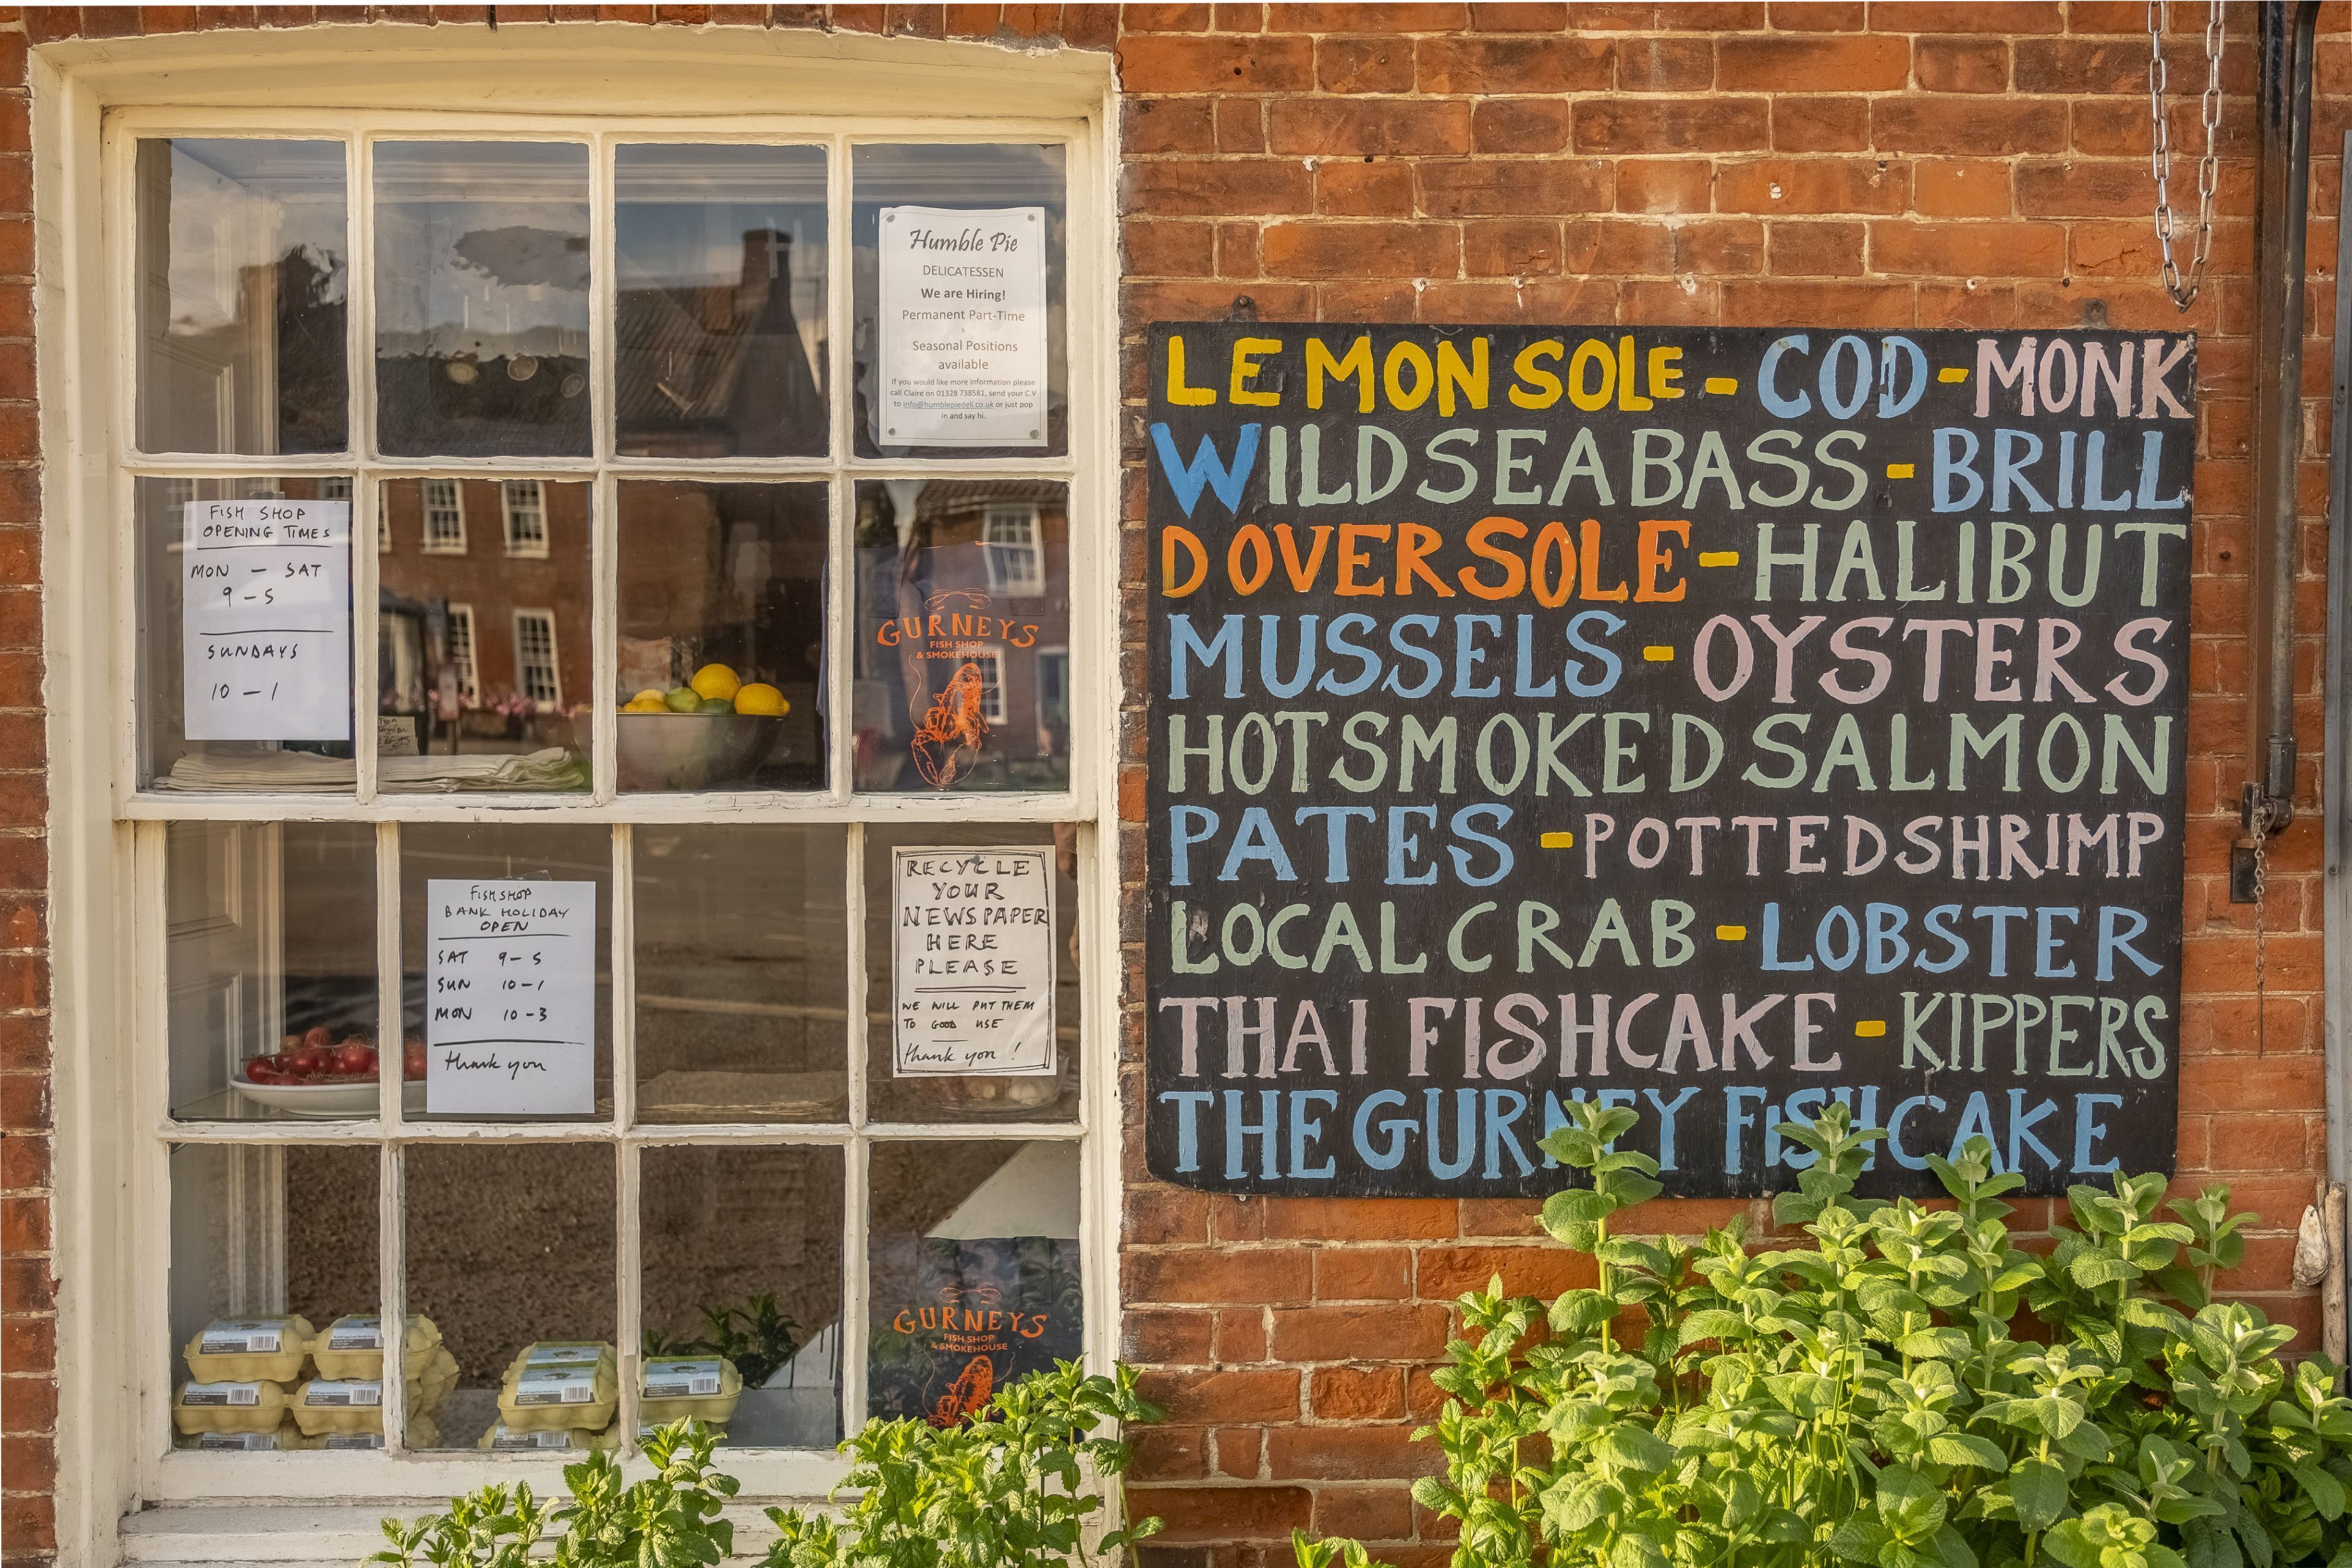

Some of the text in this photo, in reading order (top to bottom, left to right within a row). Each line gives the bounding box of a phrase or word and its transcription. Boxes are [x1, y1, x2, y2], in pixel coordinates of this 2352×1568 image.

[910, 228, 1017, 252] Humble Pie
[924, 265, 1003, 277] DELICATESSEN
[921, 288, 940, 298] We
[967, 289, 1005, 302] Hiring!
[903, 310, 1024, 321] Permanent Part-Time
[913, 340, 1017, 352] Seasonal Positions
[939, 359, 989, 369] available
[1167, 336, 1489, 417] LEMON
[1508, 336, 1684, 412] SOLE
[1757, 334, 1928, 419] COD
[1975, 337, 2194, 418] MONK
[1932, 428, 2185, 512] BRILL
[211, 505, 305, 520] FISH SHOP
[203, 524, 330, 539] OPENING TIMES
[191, 565, 228, 578] MON
[285, 562, 322, 578] SAT
[1755, 521, 2187, 606] HALIBUT
[877, 613, 1039, 647] GURNEYS
[208, 644, 298, 659] SUNDAYS
[1167, 611, 1627, 699] MUSSELS
[1694, 615, 2173, 706] OYSTERS
[1169, 804, 1514, 886] PATES
[907, 861, 1030, 877] RECYCLE
[932, 883, 1005, 900] YOUR
[446, 905, 569, 918] BANK HOLIDAY
[903, 906, 1048, 926] NEWSPAPER
[481, 921, 528, 932] OPEN
[927, 933, 998, 951] HERE
[1760, 903, 2164, 981] LOBSTER
[439, 950, 469, 965] SAT
[916, 959, 1017, 976] PLEASE
[438, 977, 470, 993] SUN
[435, 1007, 472, 1021] MON
[903, 1001, 1034, 1011] WE WILL PUT THEM
[903, 1018, 1004, 1029] TO GOOD USE
[1159, 996, 1368, 1079] THAI
[1408, 993, 1842, 1080] FISHCAKE
[1900, 992, 2168, 1080] KIPPERS
[508, 1061, 546, 1080] you
[1159, 1089, 1339, 1180] THE
[894, 1306, 1047, 1338] GURNEYS
[940, 1343, 1008, 1353] SMOKEHOUSE
